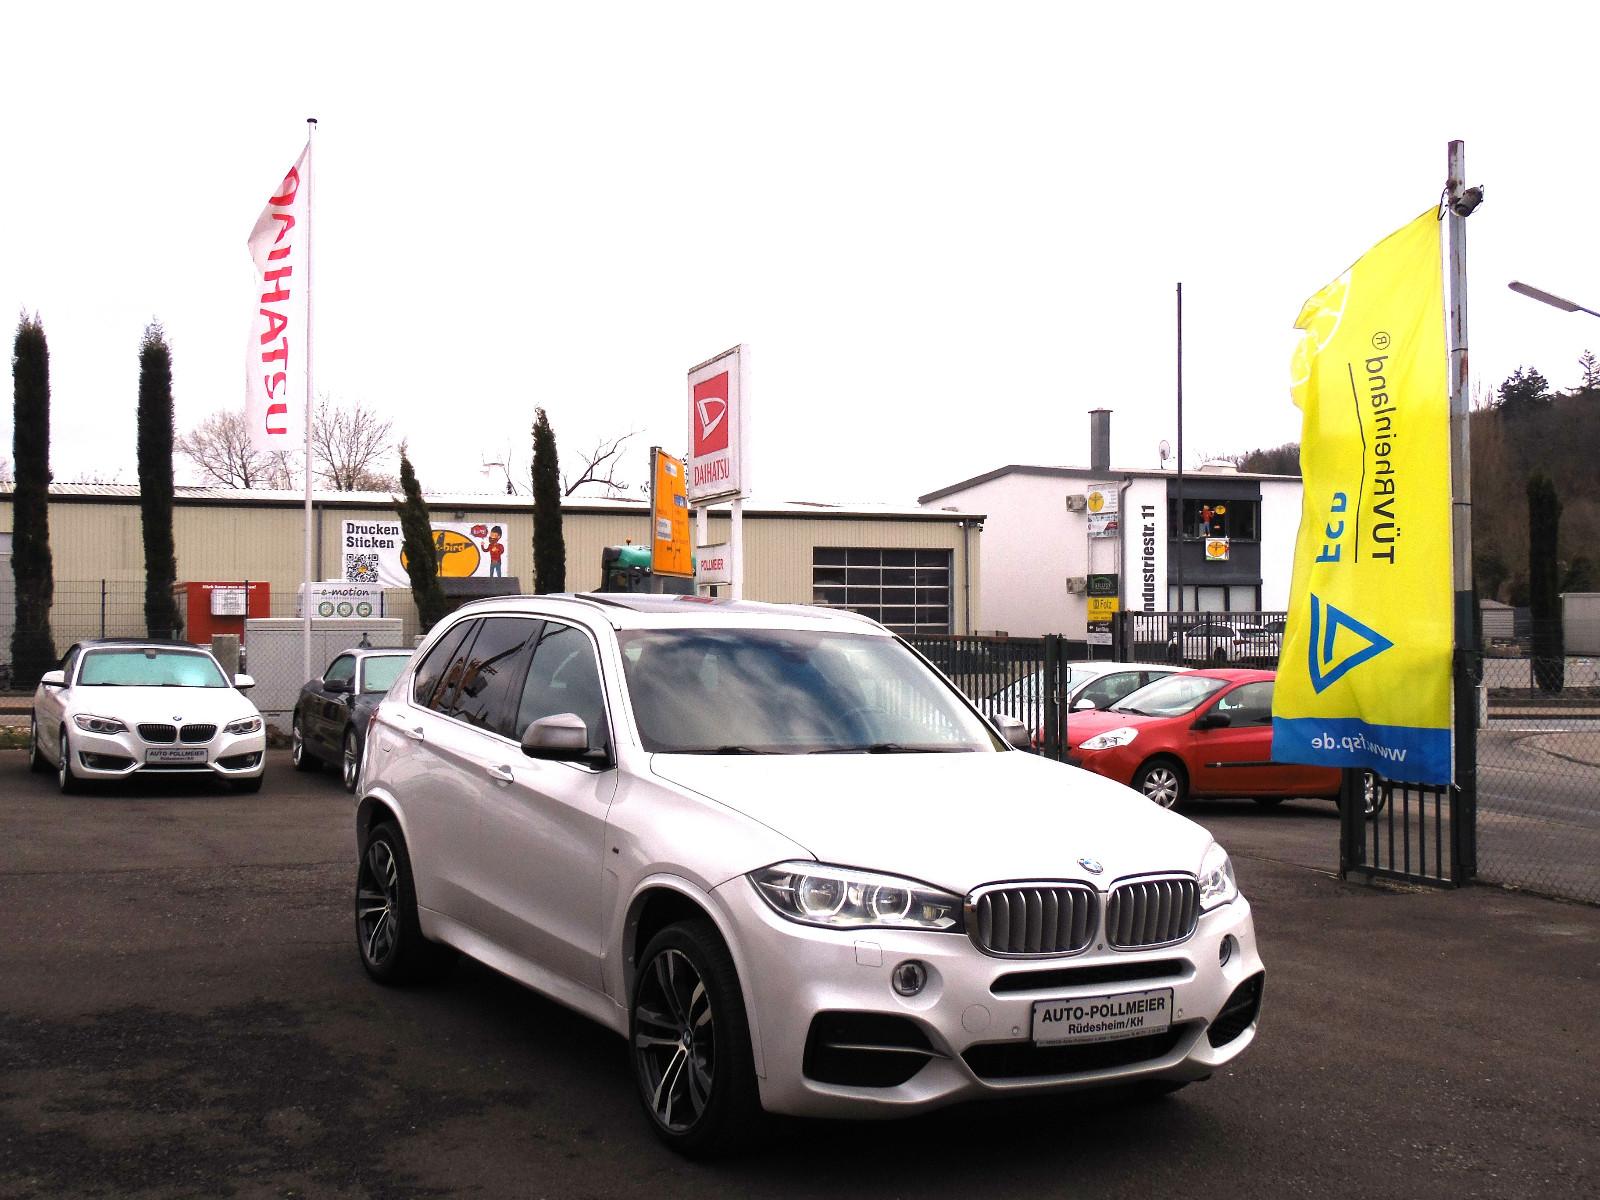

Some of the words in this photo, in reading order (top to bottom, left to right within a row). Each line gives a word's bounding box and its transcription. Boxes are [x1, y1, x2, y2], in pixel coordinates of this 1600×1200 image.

[259, 165, 301, 436] DAIHATSU
[694, 457, 730, 487] DAIHATSU
[1141, 505, 1155, 520] 11
[346, 522, 400, 535] Drucken
[346, 536, 395, 549] Sticken
[700, 558, 724, 571] POLLMEIER
[1141, 522, 1155, 613] ndustriestr.
[320, 586, 370, 597] e-motion
[1041, 997, 1165, 1023] AUTO-POLLMEIER
[1068, 1016, 1144, 1034] Rüdesheim/KH
